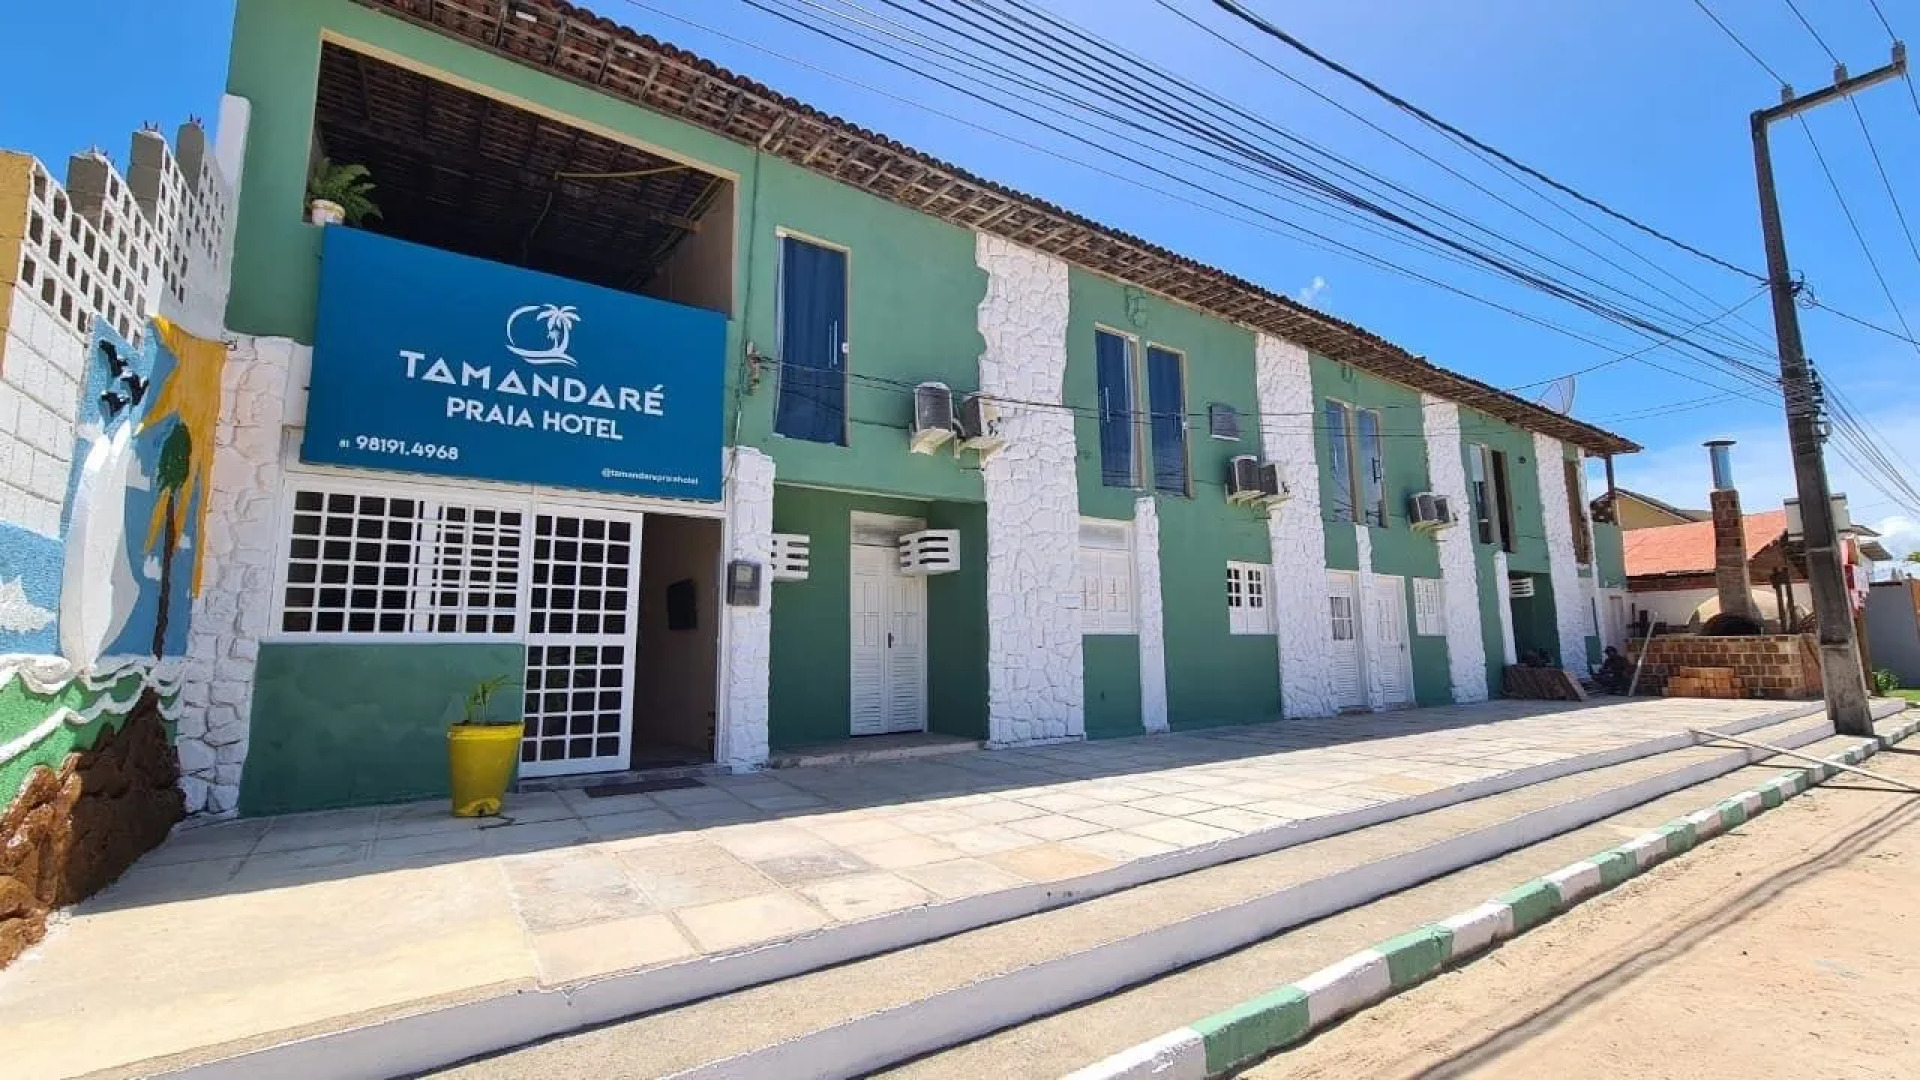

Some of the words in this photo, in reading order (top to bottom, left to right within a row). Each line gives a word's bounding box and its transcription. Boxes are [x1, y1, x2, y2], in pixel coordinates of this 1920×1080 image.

[399, 349, 665, 416] TAMANDARÉ
[446, 396, 535, 429] PRAIA
[542, 410, 624, 441] HOTEL
[356, 434, 459, 460] 98191.4968
